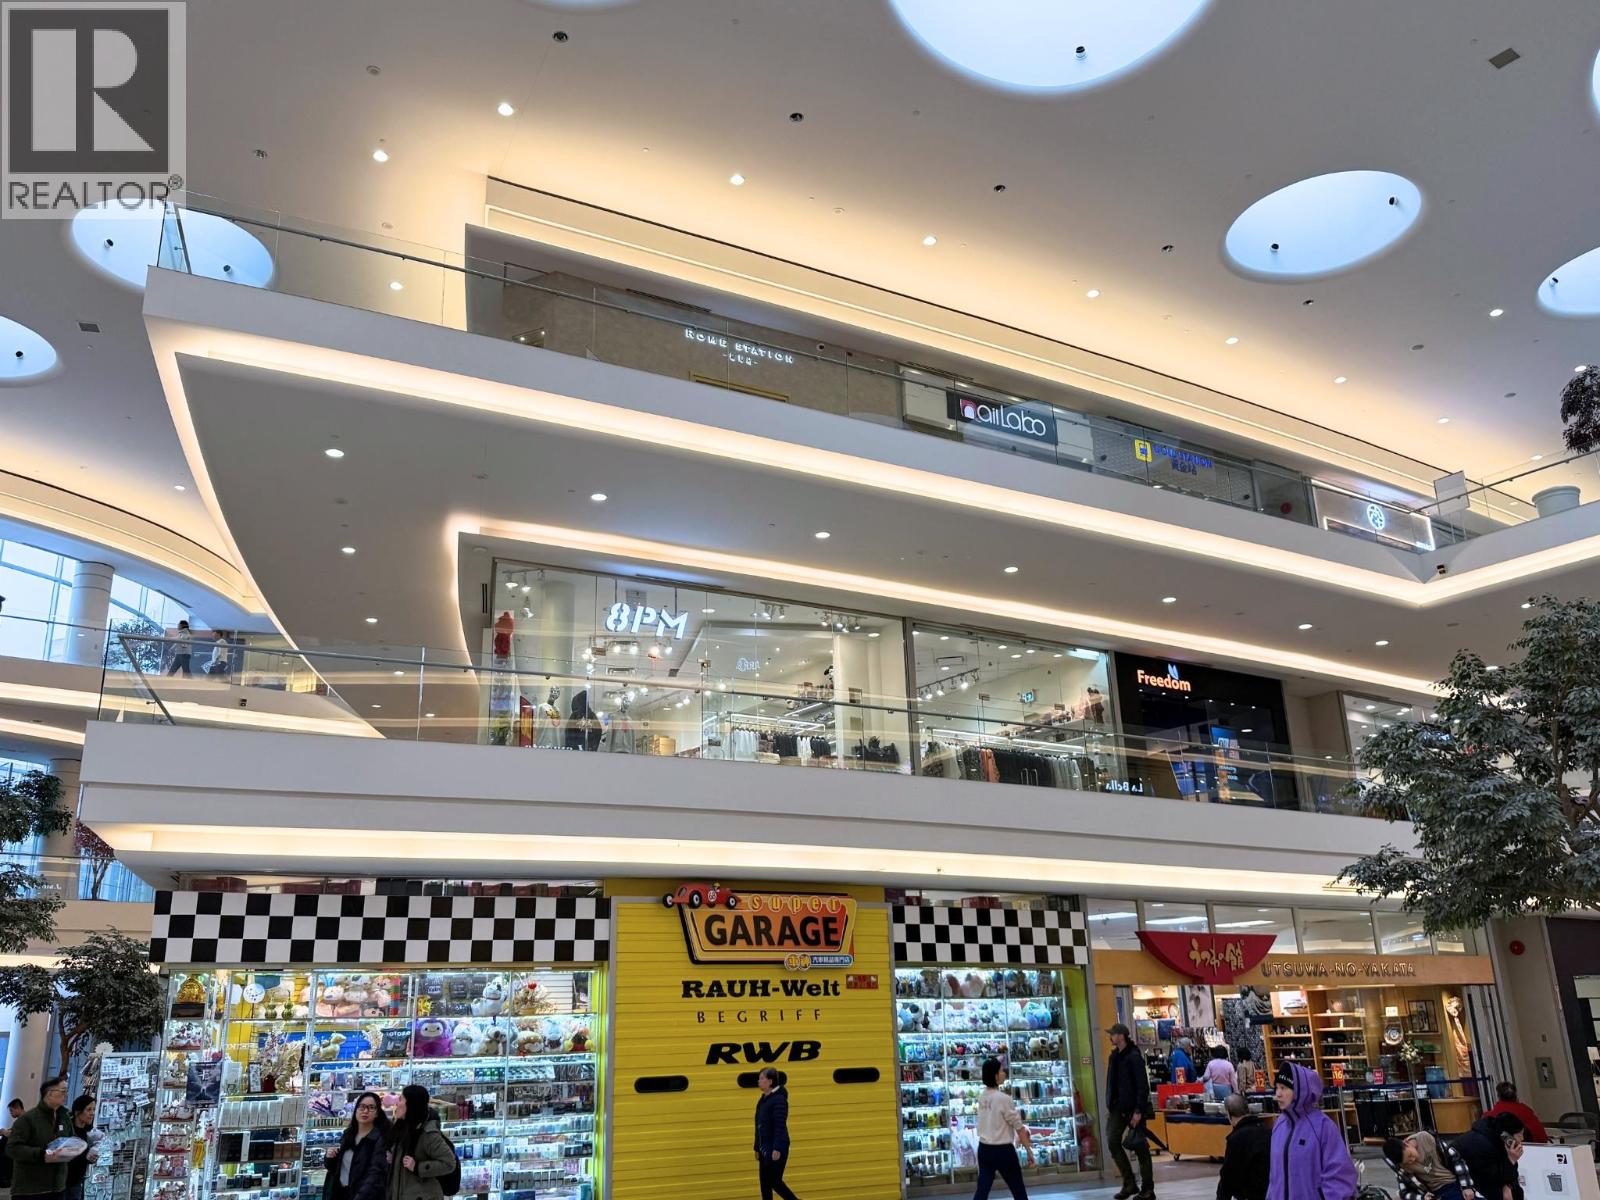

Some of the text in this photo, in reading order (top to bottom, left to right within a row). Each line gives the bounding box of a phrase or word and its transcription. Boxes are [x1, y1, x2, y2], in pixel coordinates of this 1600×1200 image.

[605, 602, 688, 640] 8PM
[1137, 669, 1191, 692] Freedom
[704, 913, 841, 948] GARAGE
[681, 978, 841, 998] RAUH-Welt
[697, 1008, 821, 1023] BEGRIFF
[705, 1040, 822, 1065] RWB
